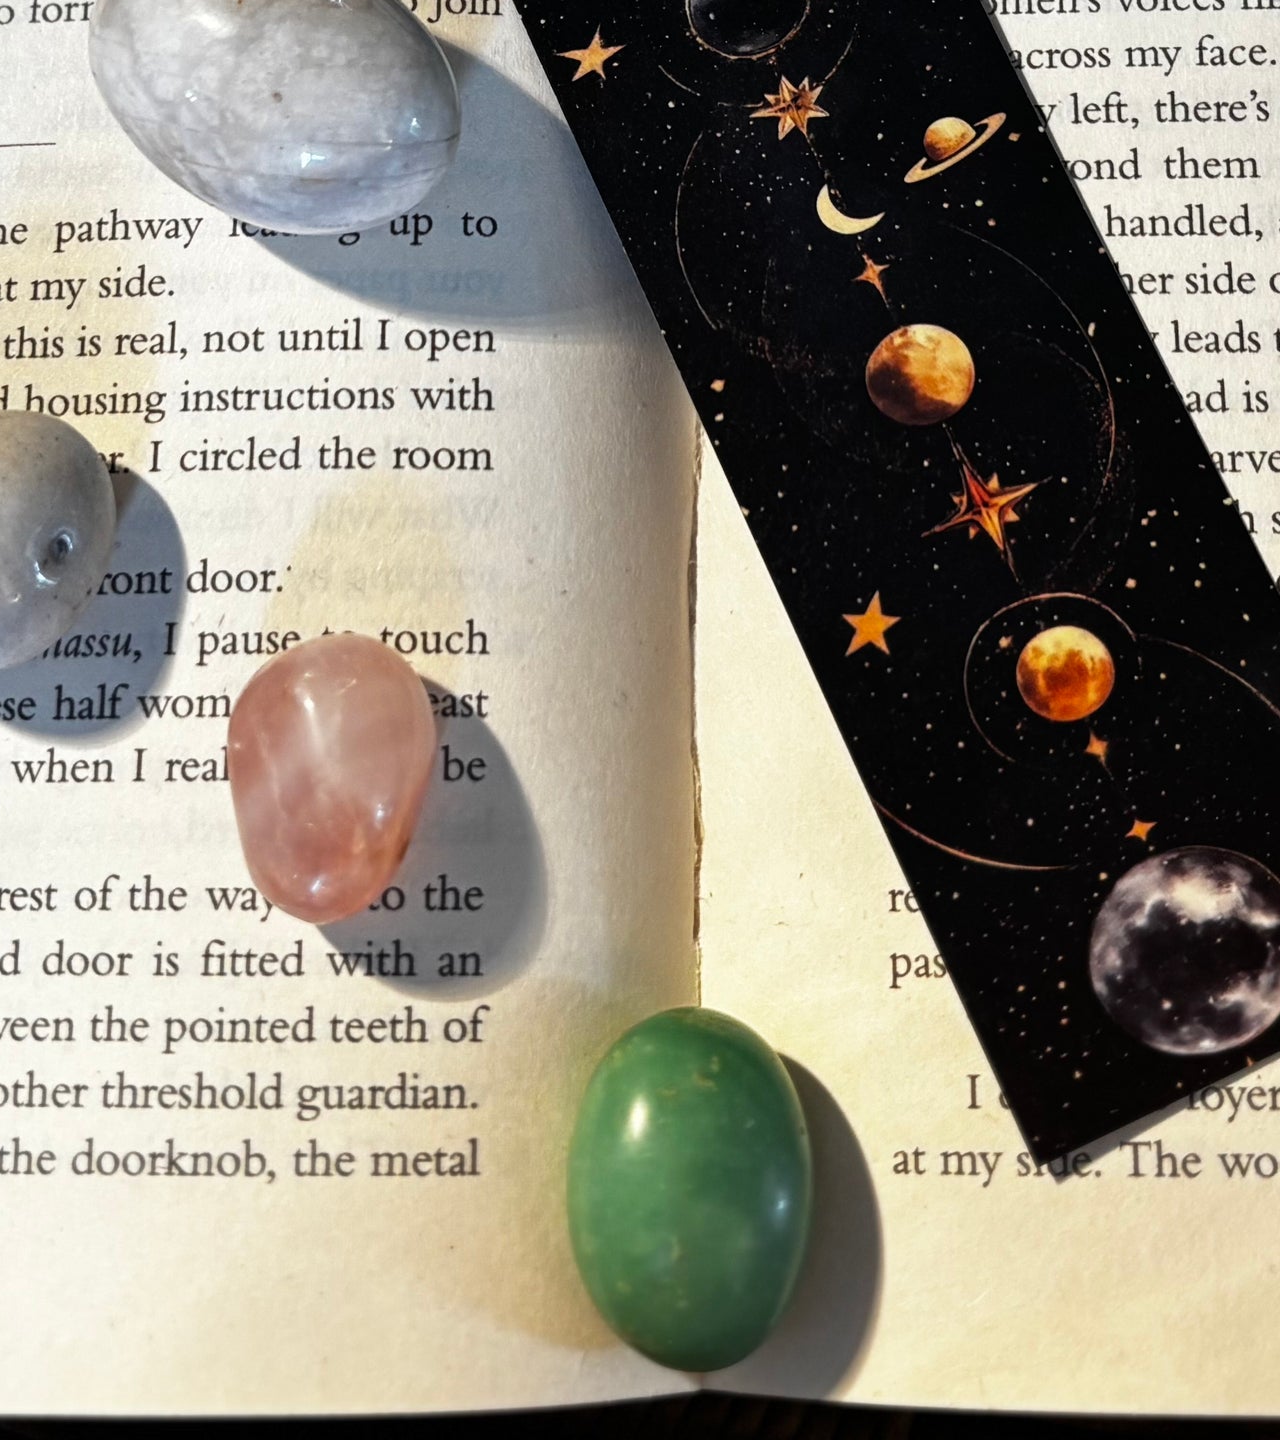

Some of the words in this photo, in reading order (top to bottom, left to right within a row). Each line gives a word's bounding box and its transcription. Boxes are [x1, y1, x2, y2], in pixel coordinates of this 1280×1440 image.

[1068, 89, 1141, 131] left,
[1152, 87, 1271, 125] there’s
[1102, 201, 1265, 244] handled,
[28, 277, 89, 312] my
[97, 262, 176, 300] side.
[9, 746, 116, 785] when
[131, 746, 149, 784] I
[439, 742, 488, 784] be
[40, 938, 135, 978] door
[151, 939, 181, 978] is
[199, 937, 306, 978] fitted
[326, 936, 420, 979] with
[436, 950, 485, 979] an
[100, 1069, 286, 1111] threshold
[295, 1070, 480, 1123] guardian.
[70, 1136, 277, 1185] doorknob,
[292, 1137, 357, 1179] the
[369, 1136, 482, 1179] metal
[891, 1145, 928, 1177] at
[938, 1149, 1004, 1190] my
[1119, 1137, 1203, 1180] The
